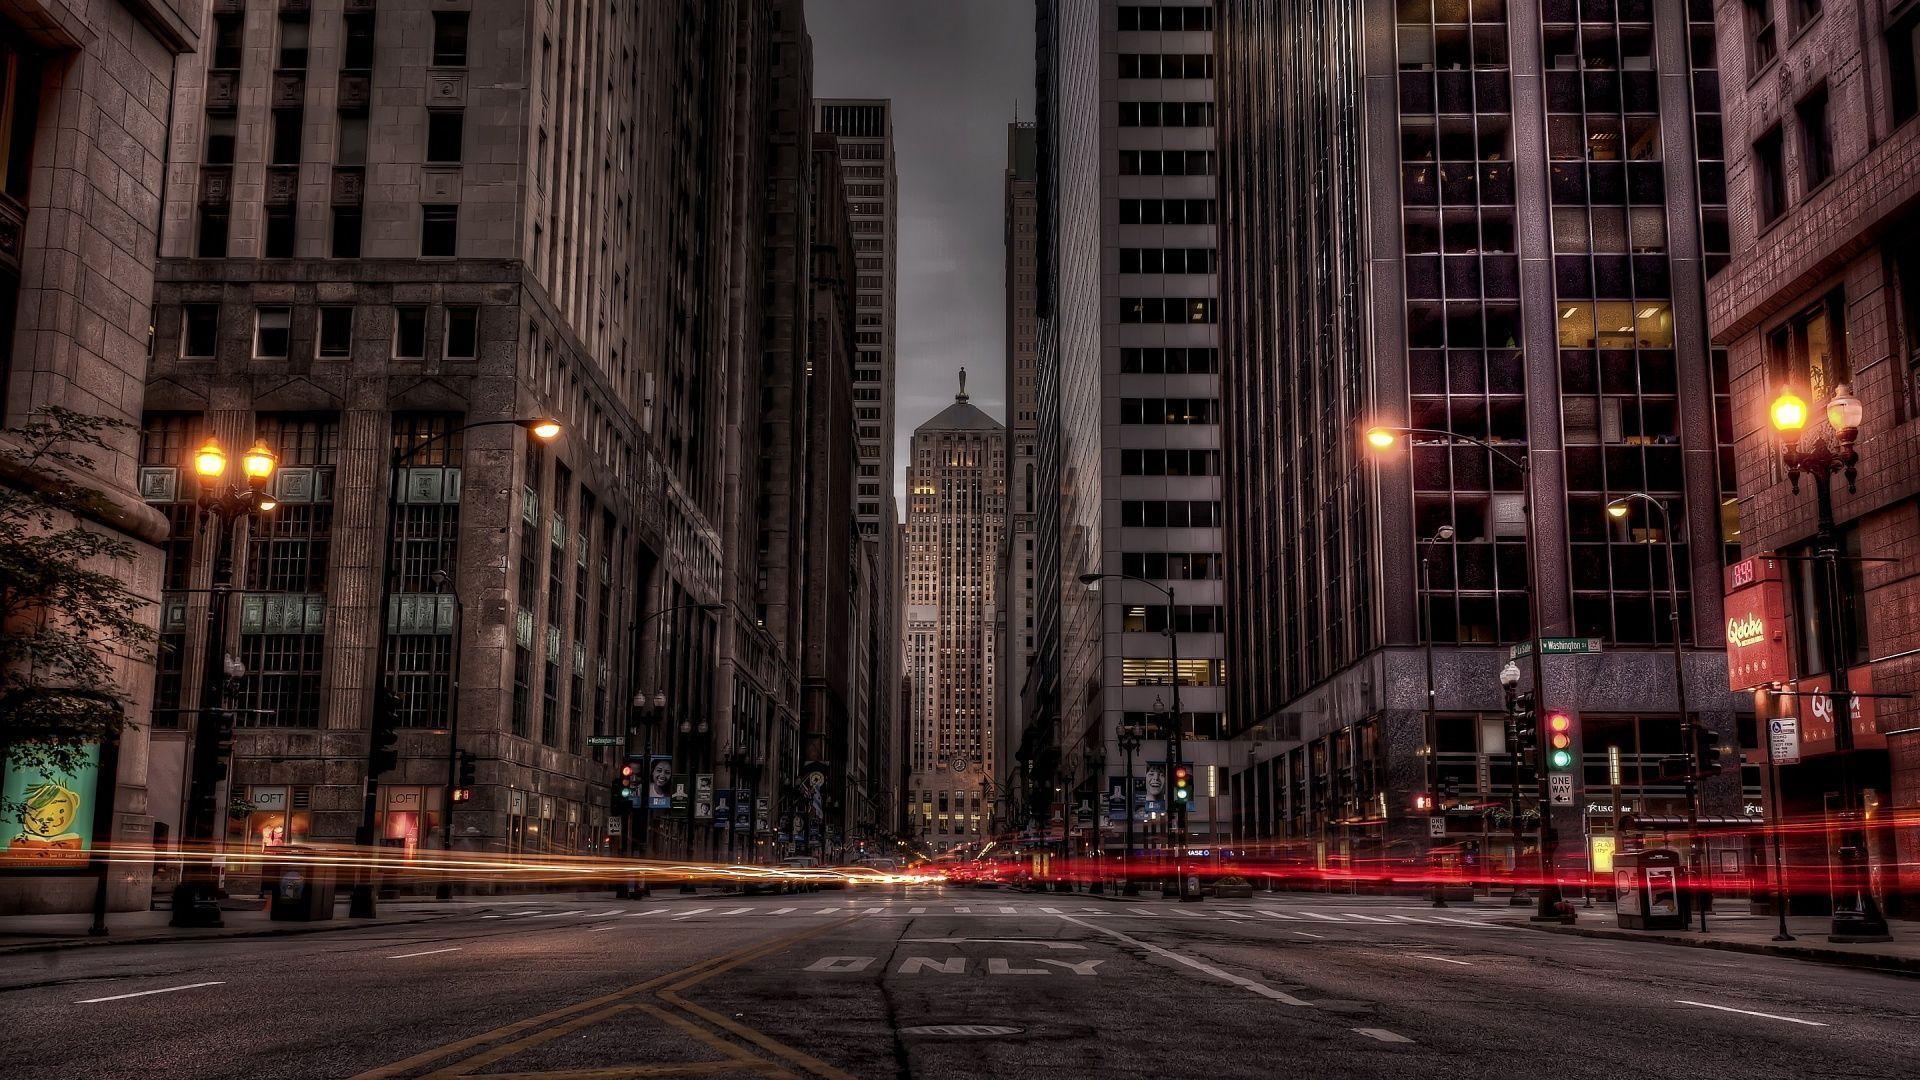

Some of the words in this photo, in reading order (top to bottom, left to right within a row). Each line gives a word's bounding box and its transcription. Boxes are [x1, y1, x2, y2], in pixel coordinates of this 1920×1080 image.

[1727, 612, 1764, 648] Qdoba
[1548, 640, 1581, 652] Washington
[1551, 776, 1570, 784] ONE
[1551, 785, 1571, 793] WAY
[254, 793, 284, 803] LOFT
[389, 793, 419, 803] LOFT
[802, 956, 1106, 976] ONLY
